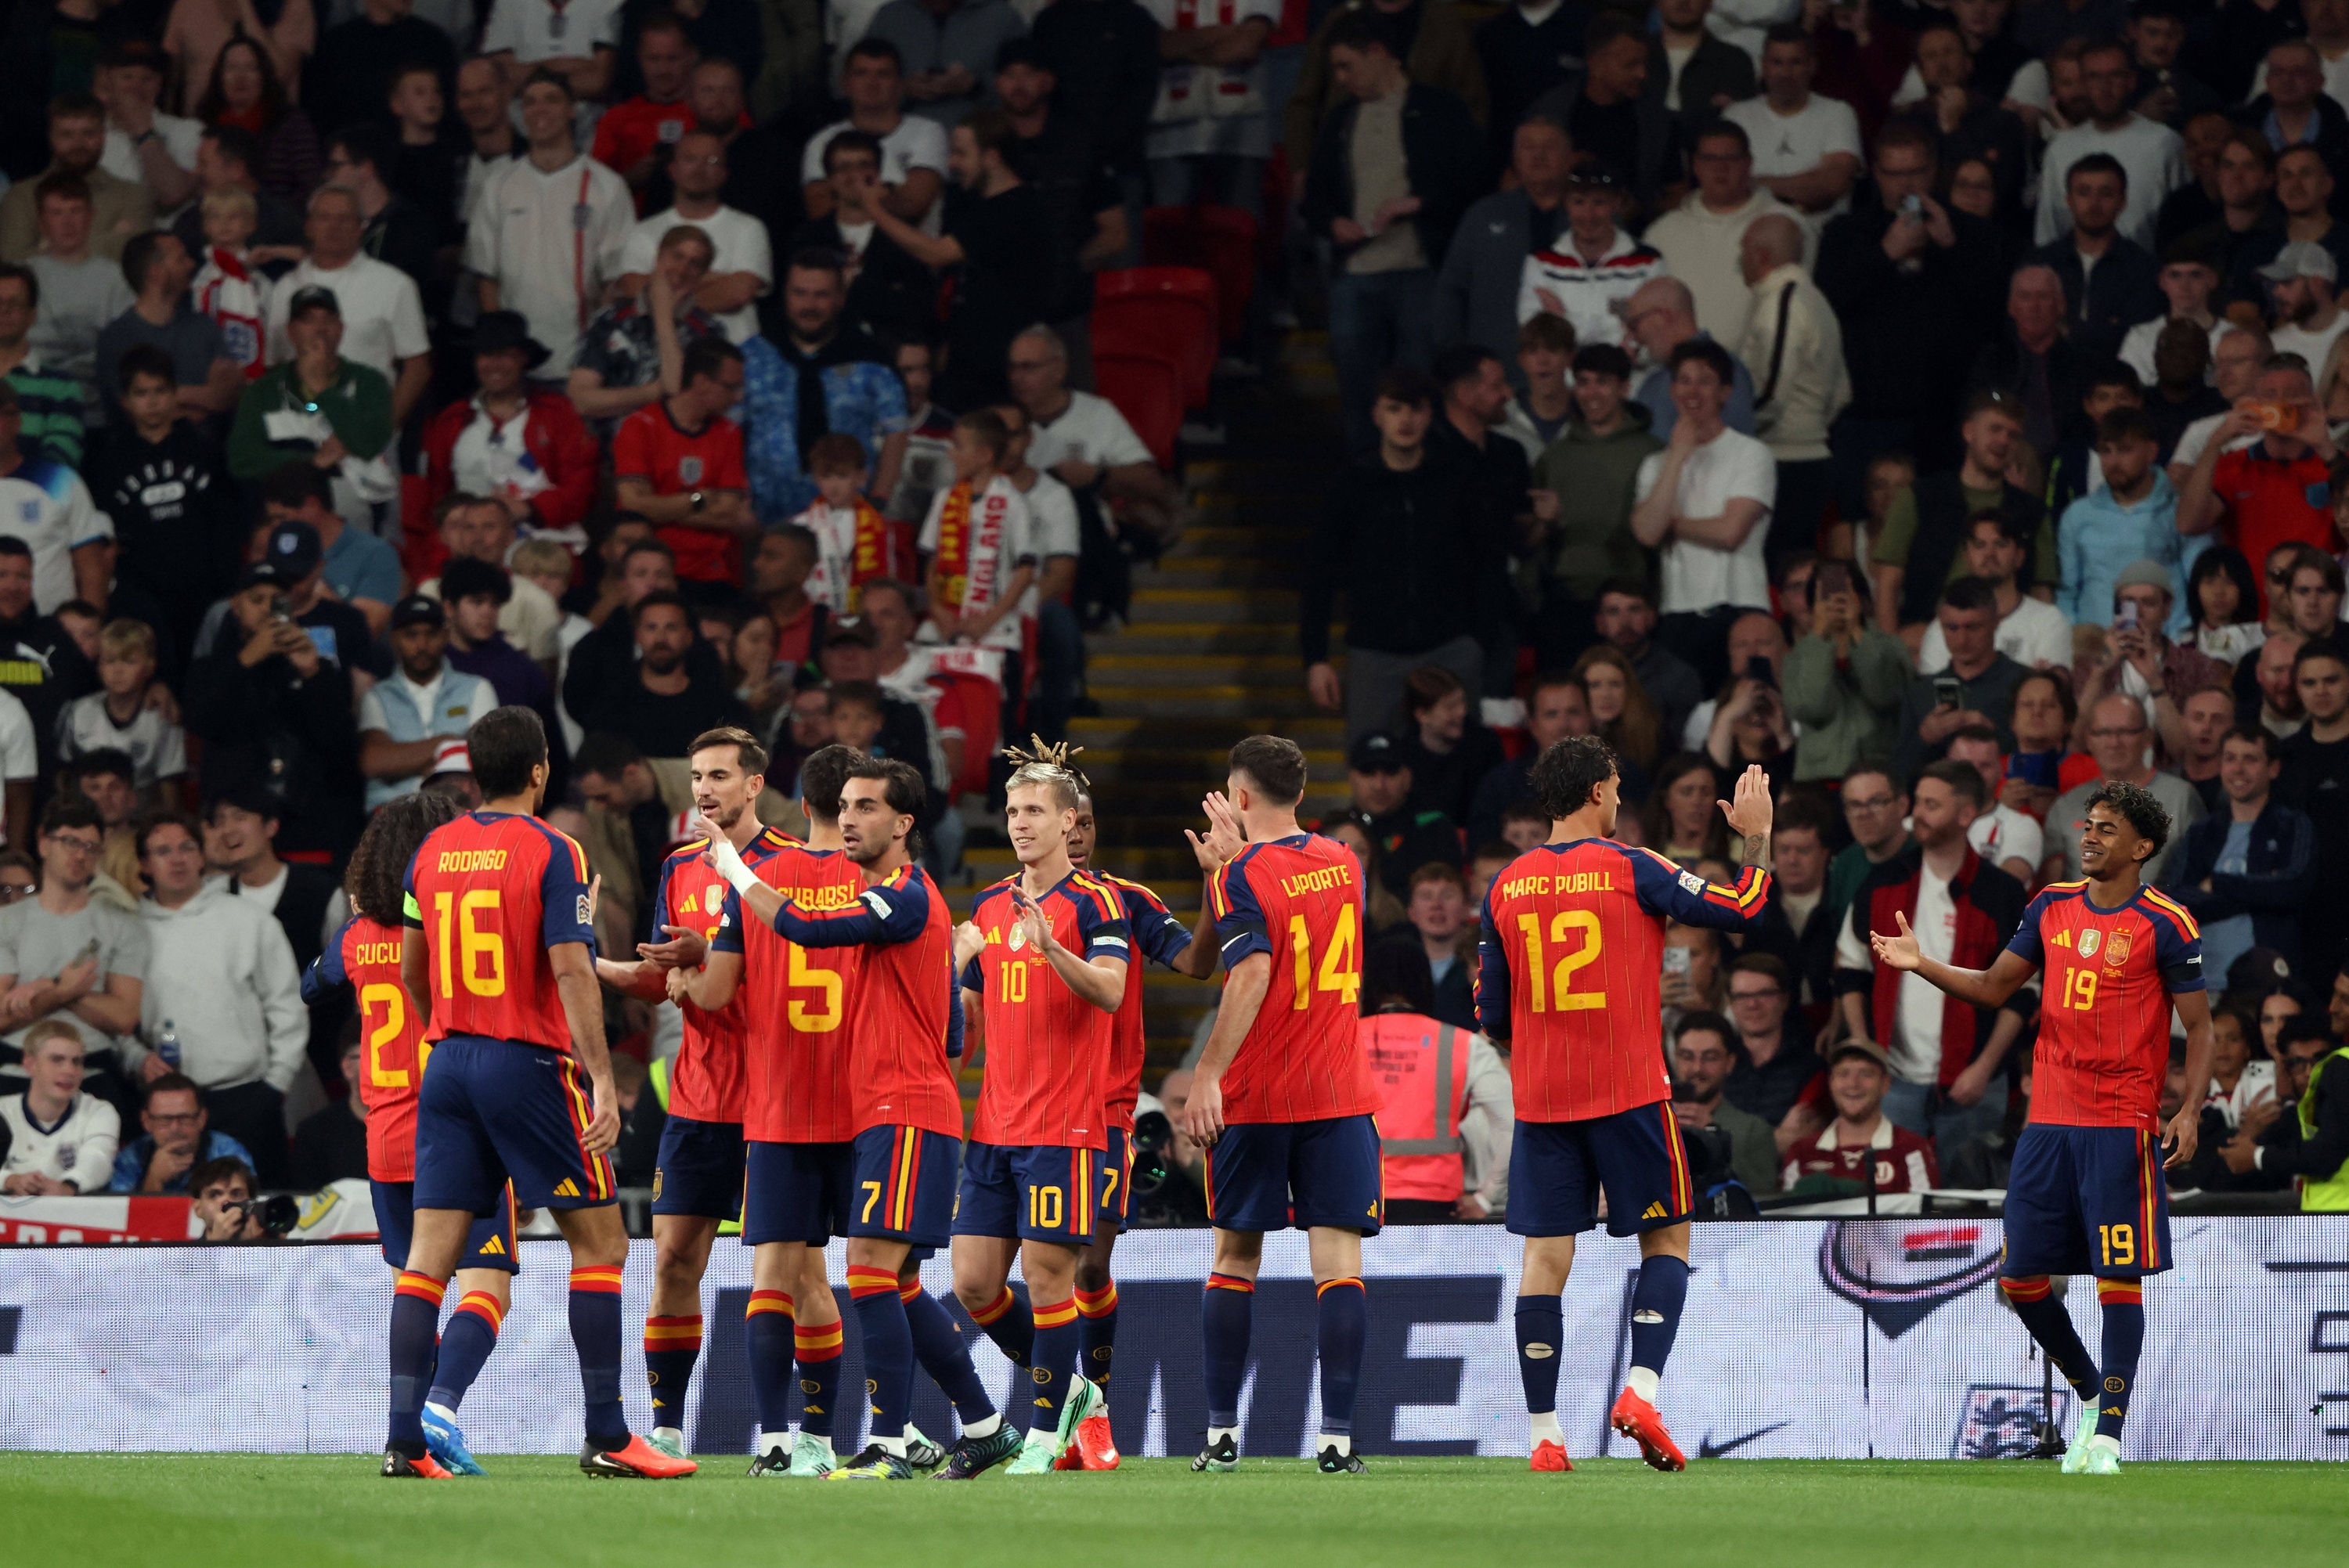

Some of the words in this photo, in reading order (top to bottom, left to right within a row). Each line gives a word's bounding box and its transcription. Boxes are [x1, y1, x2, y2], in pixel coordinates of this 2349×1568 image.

[438, 849, 507, 873] RODRIGO
[1280, 864, 1352, 898] LAPORTE
[1503, 876, 1550, 902] MARC
[1555, 871, 1615, 895] PUBILL
[435, 889, 505, 998] 16
[1289, 903, 1360, 1010] 14
[1517, 909, 1607, 1012] 12
[788, 940, 843, 1033] 5
[1001, 961, 1027, 1003] 10
[2063, 967, 2097, 1011] 19
[861, 1181, 882, 1224] 7
[1029, 1185, 1063, 1227] 10
[2099, 1224, 2134, 1266] 19
